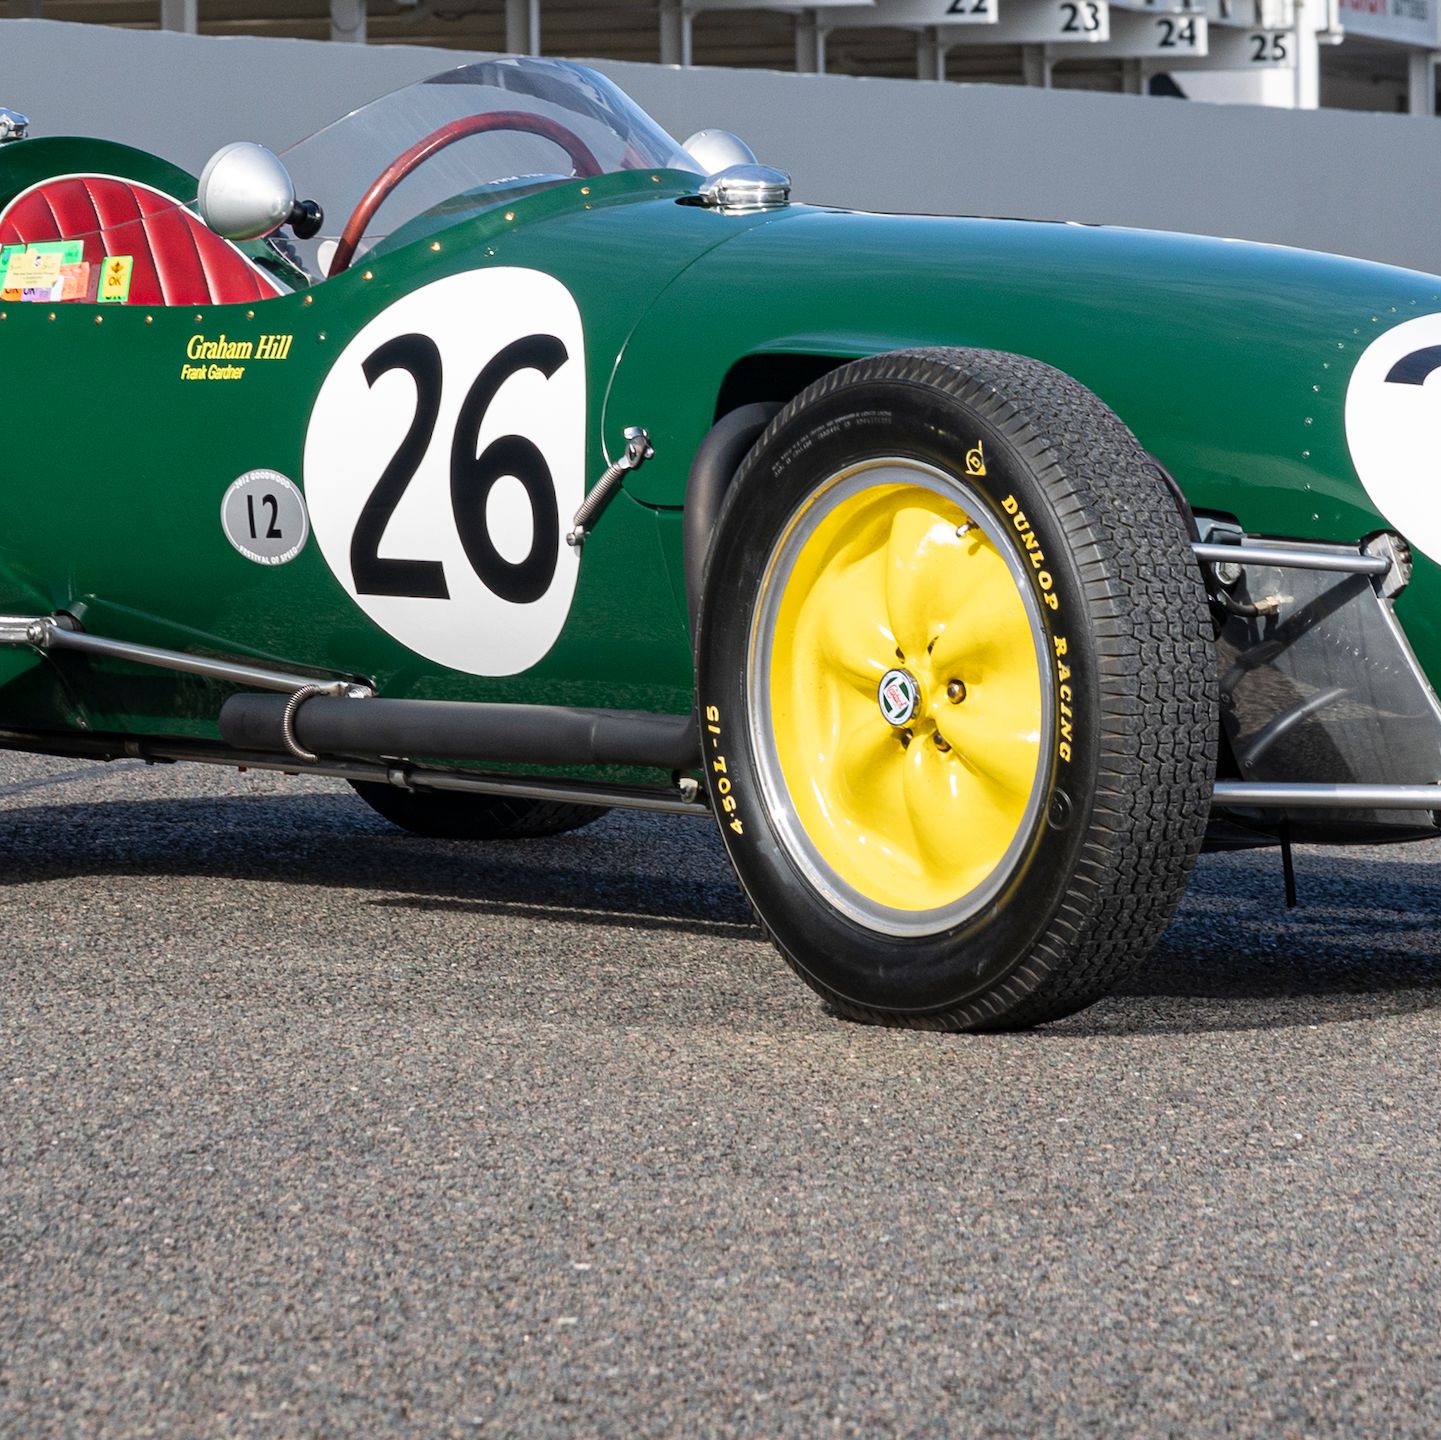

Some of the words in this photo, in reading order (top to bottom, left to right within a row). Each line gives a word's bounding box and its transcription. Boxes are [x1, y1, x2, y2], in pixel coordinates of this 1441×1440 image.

[1060, 2, 1100, 32] 23
[1157, 19, 1196, 48] 24
[1250, 34, 1287, 61] 25
[187, 335, 253, 359] Graham
[254, 335, 293, 359] Hill
[181, 364, 208, 380] Frank
[208, 364, 245, 380] Gardner
[350, 333, 569, 604] 26
[247, 494, 282, 539] 12
[239, 545, 270, 565] FESTIVAL
[1001, 494, 1059, 610] DUNLOP
[1053, 635, 1073, 763] RACING
